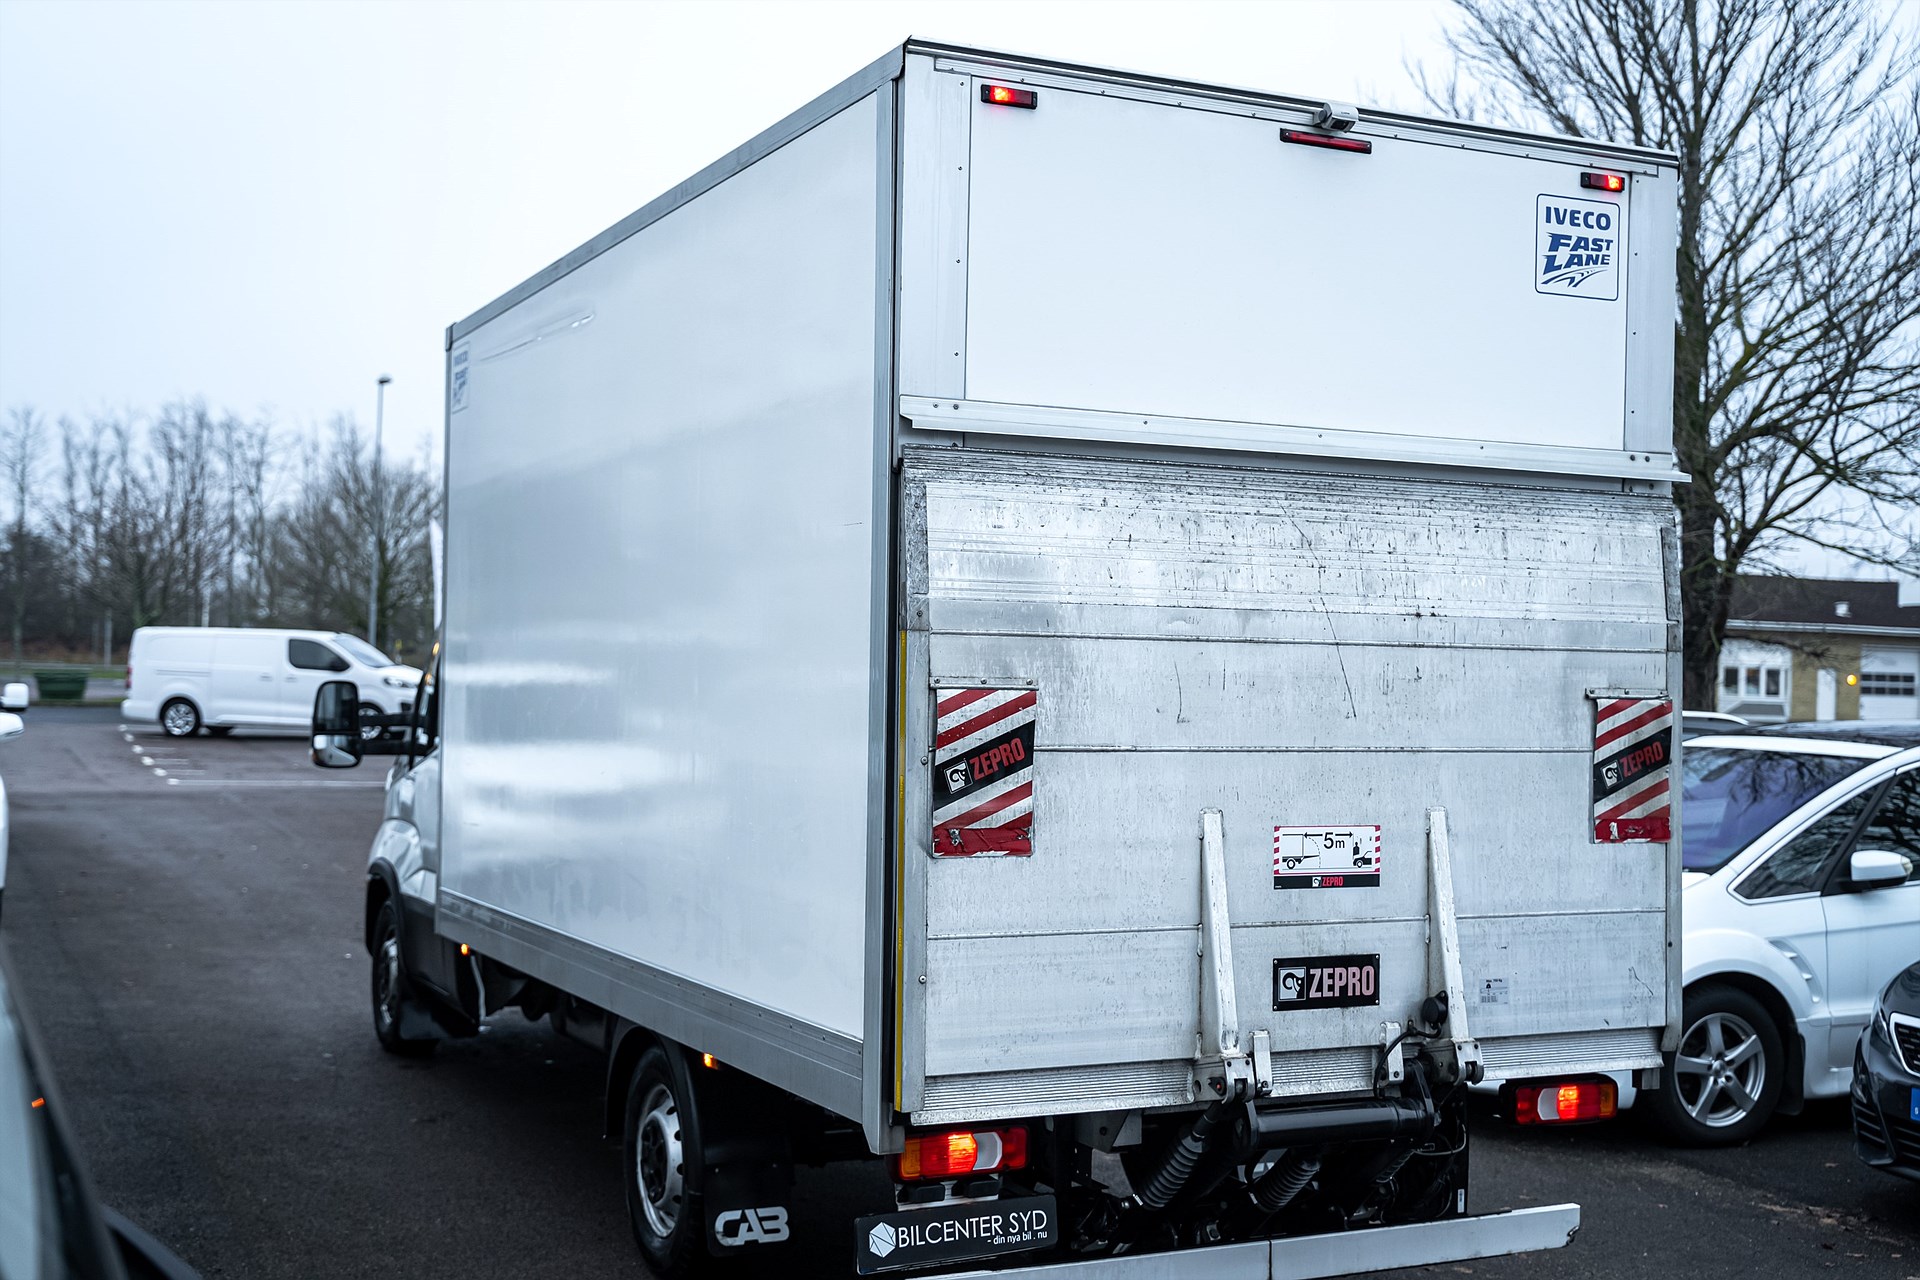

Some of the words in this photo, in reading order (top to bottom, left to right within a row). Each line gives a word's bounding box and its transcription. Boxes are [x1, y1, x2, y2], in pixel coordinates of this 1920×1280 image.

[1545, 206, 1611, 231] IVECO
[1546, 232, 1613, 252] FAST
[1542, 253, 1611, 275] LANE
[970, 737, 1025, 780] ZEPRO
[1620, 741, 1664, 778] ZEPRO
[1321, 876, 1344, 887] ZEPRO
[1309, 965, 1375, 998] ZEPRO
[715, 1206, 790, 1247] CAB
[898, 1215, 1003, 1248] BILCENTER
[1009, 1210, 1047, 1233] SYD
[993, 1234, 1005, 1244] din
[1007, 1234, 1021, 1244] nya
[1022, 1231, 1032, 1241] bil
[1037, 1231, 1048, 1239] nu
